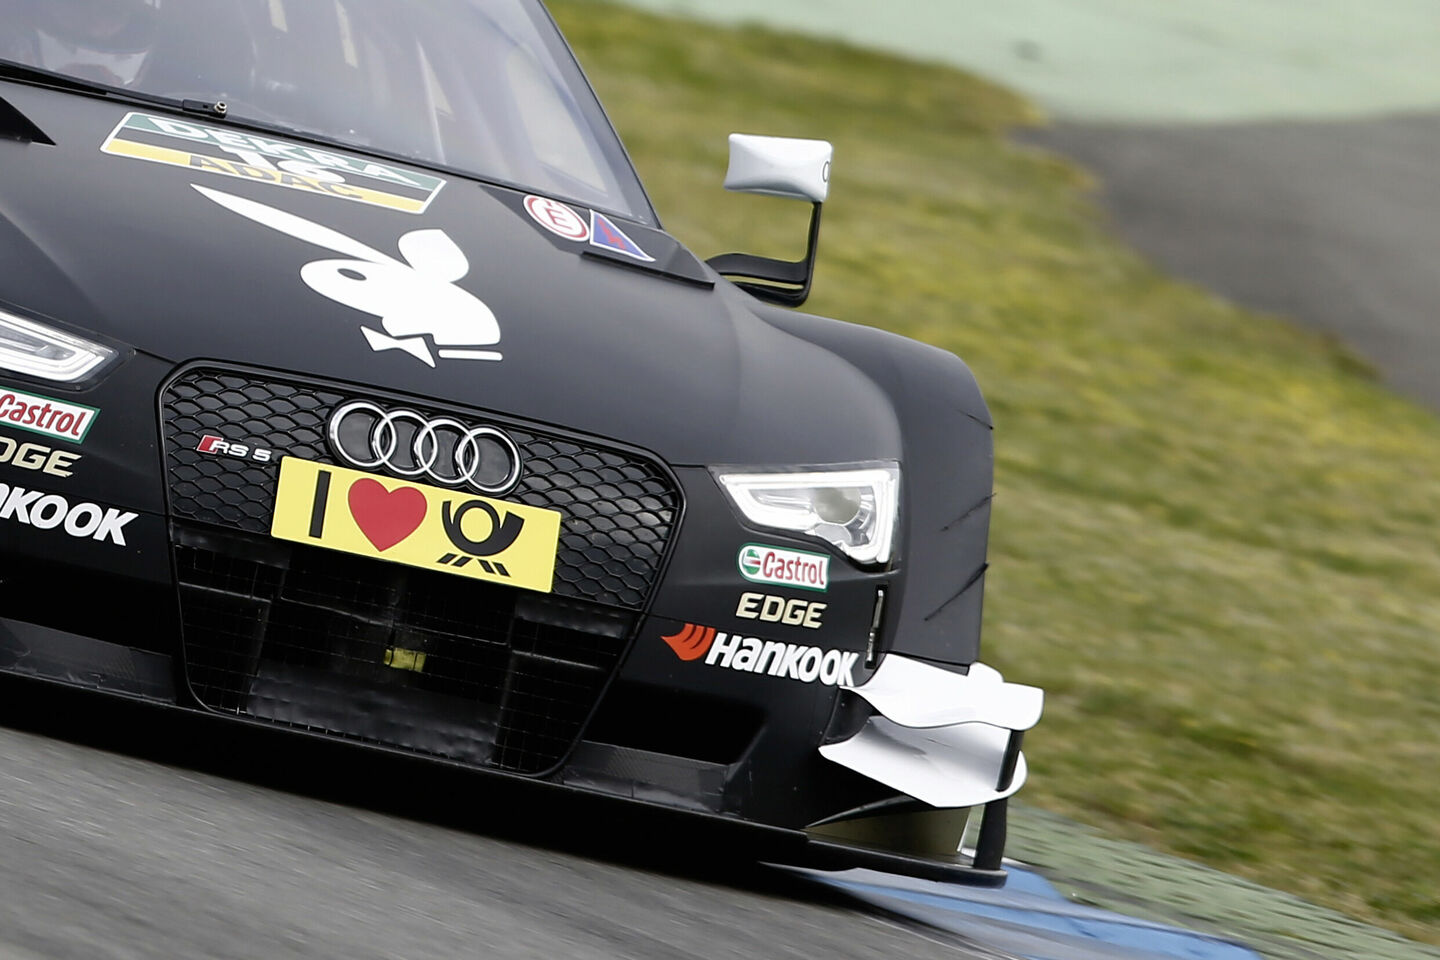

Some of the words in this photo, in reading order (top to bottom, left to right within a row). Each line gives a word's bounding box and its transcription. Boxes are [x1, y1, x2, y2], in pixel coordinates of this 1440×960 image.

[148, 118, 422, 187] DEKRA
[217, 144, 346, 184] 16
[189, 154, 363, 200] ADAC
[208, 439, 250, 457] RS
[252, 448, 272, 462] 5
[308, 470, 332, 539] I
[761, 550, 826, 586] Castrol
[736, 592, 827, 629] EDGE
